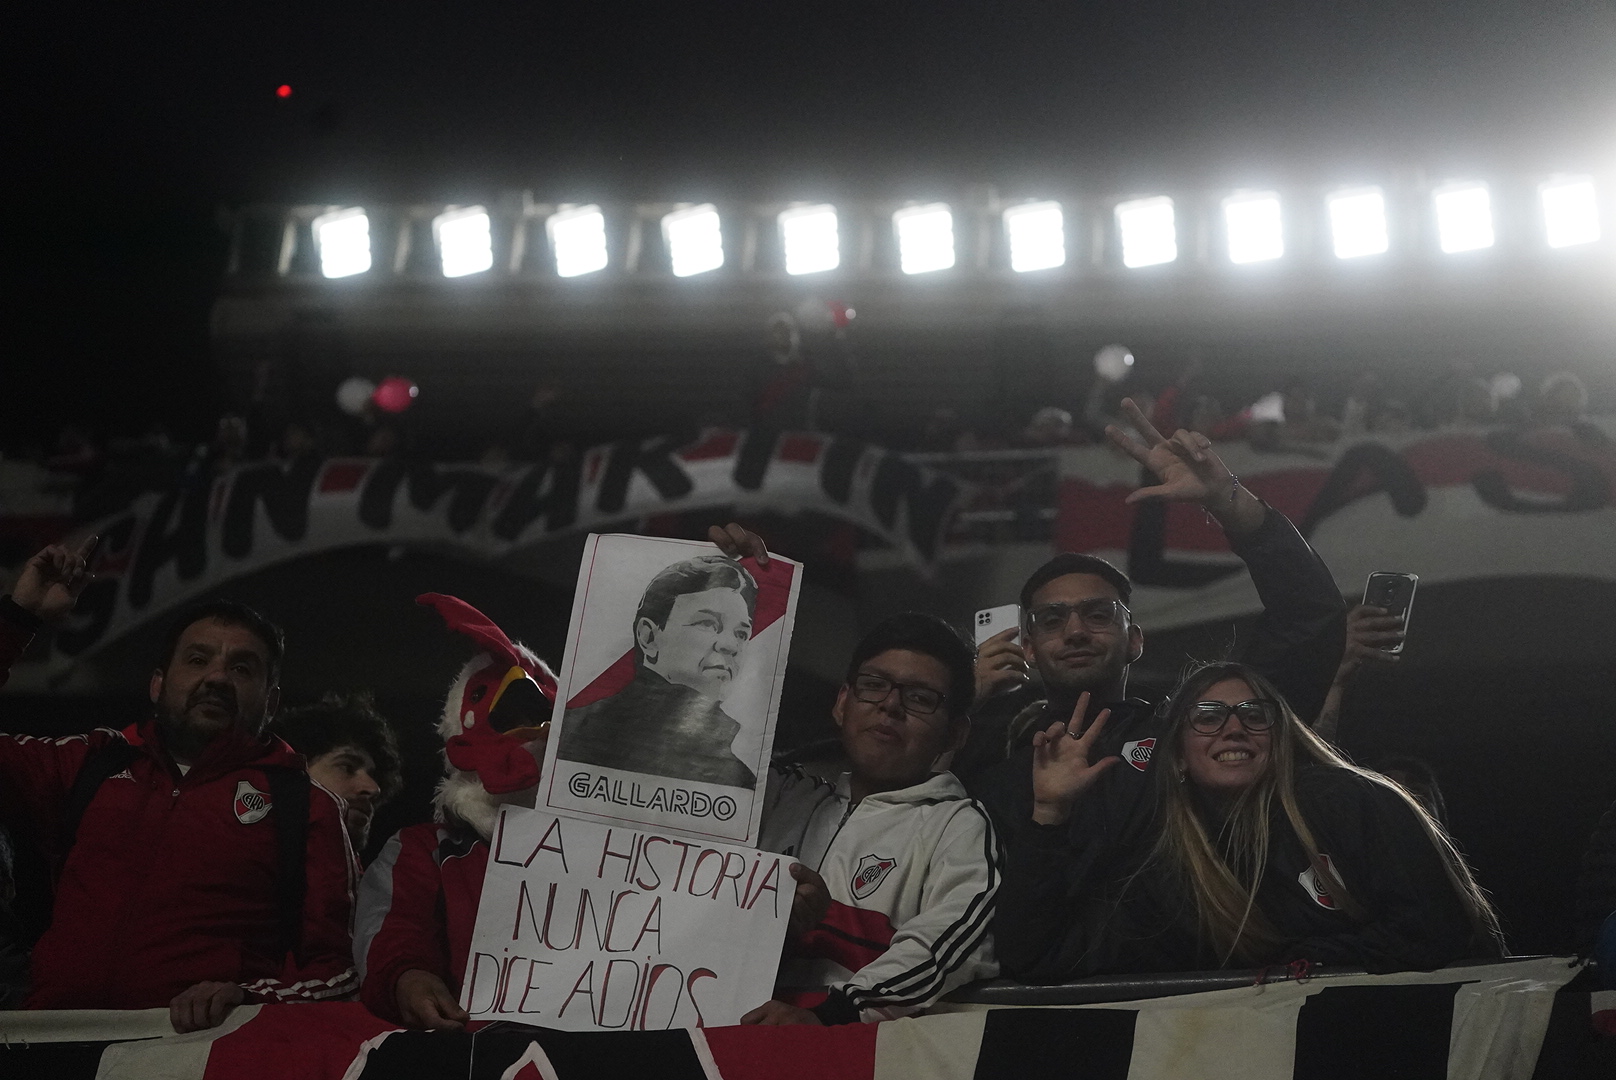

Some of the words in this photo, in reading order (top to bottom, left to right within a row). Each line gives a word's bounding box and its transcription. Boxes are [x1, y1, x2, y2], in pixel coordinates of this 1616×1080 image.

[568, 772, 737, 821] GALLARDO
[494, 810, 569, 874] LA
[512, 880, 664, 955] NUNCA
